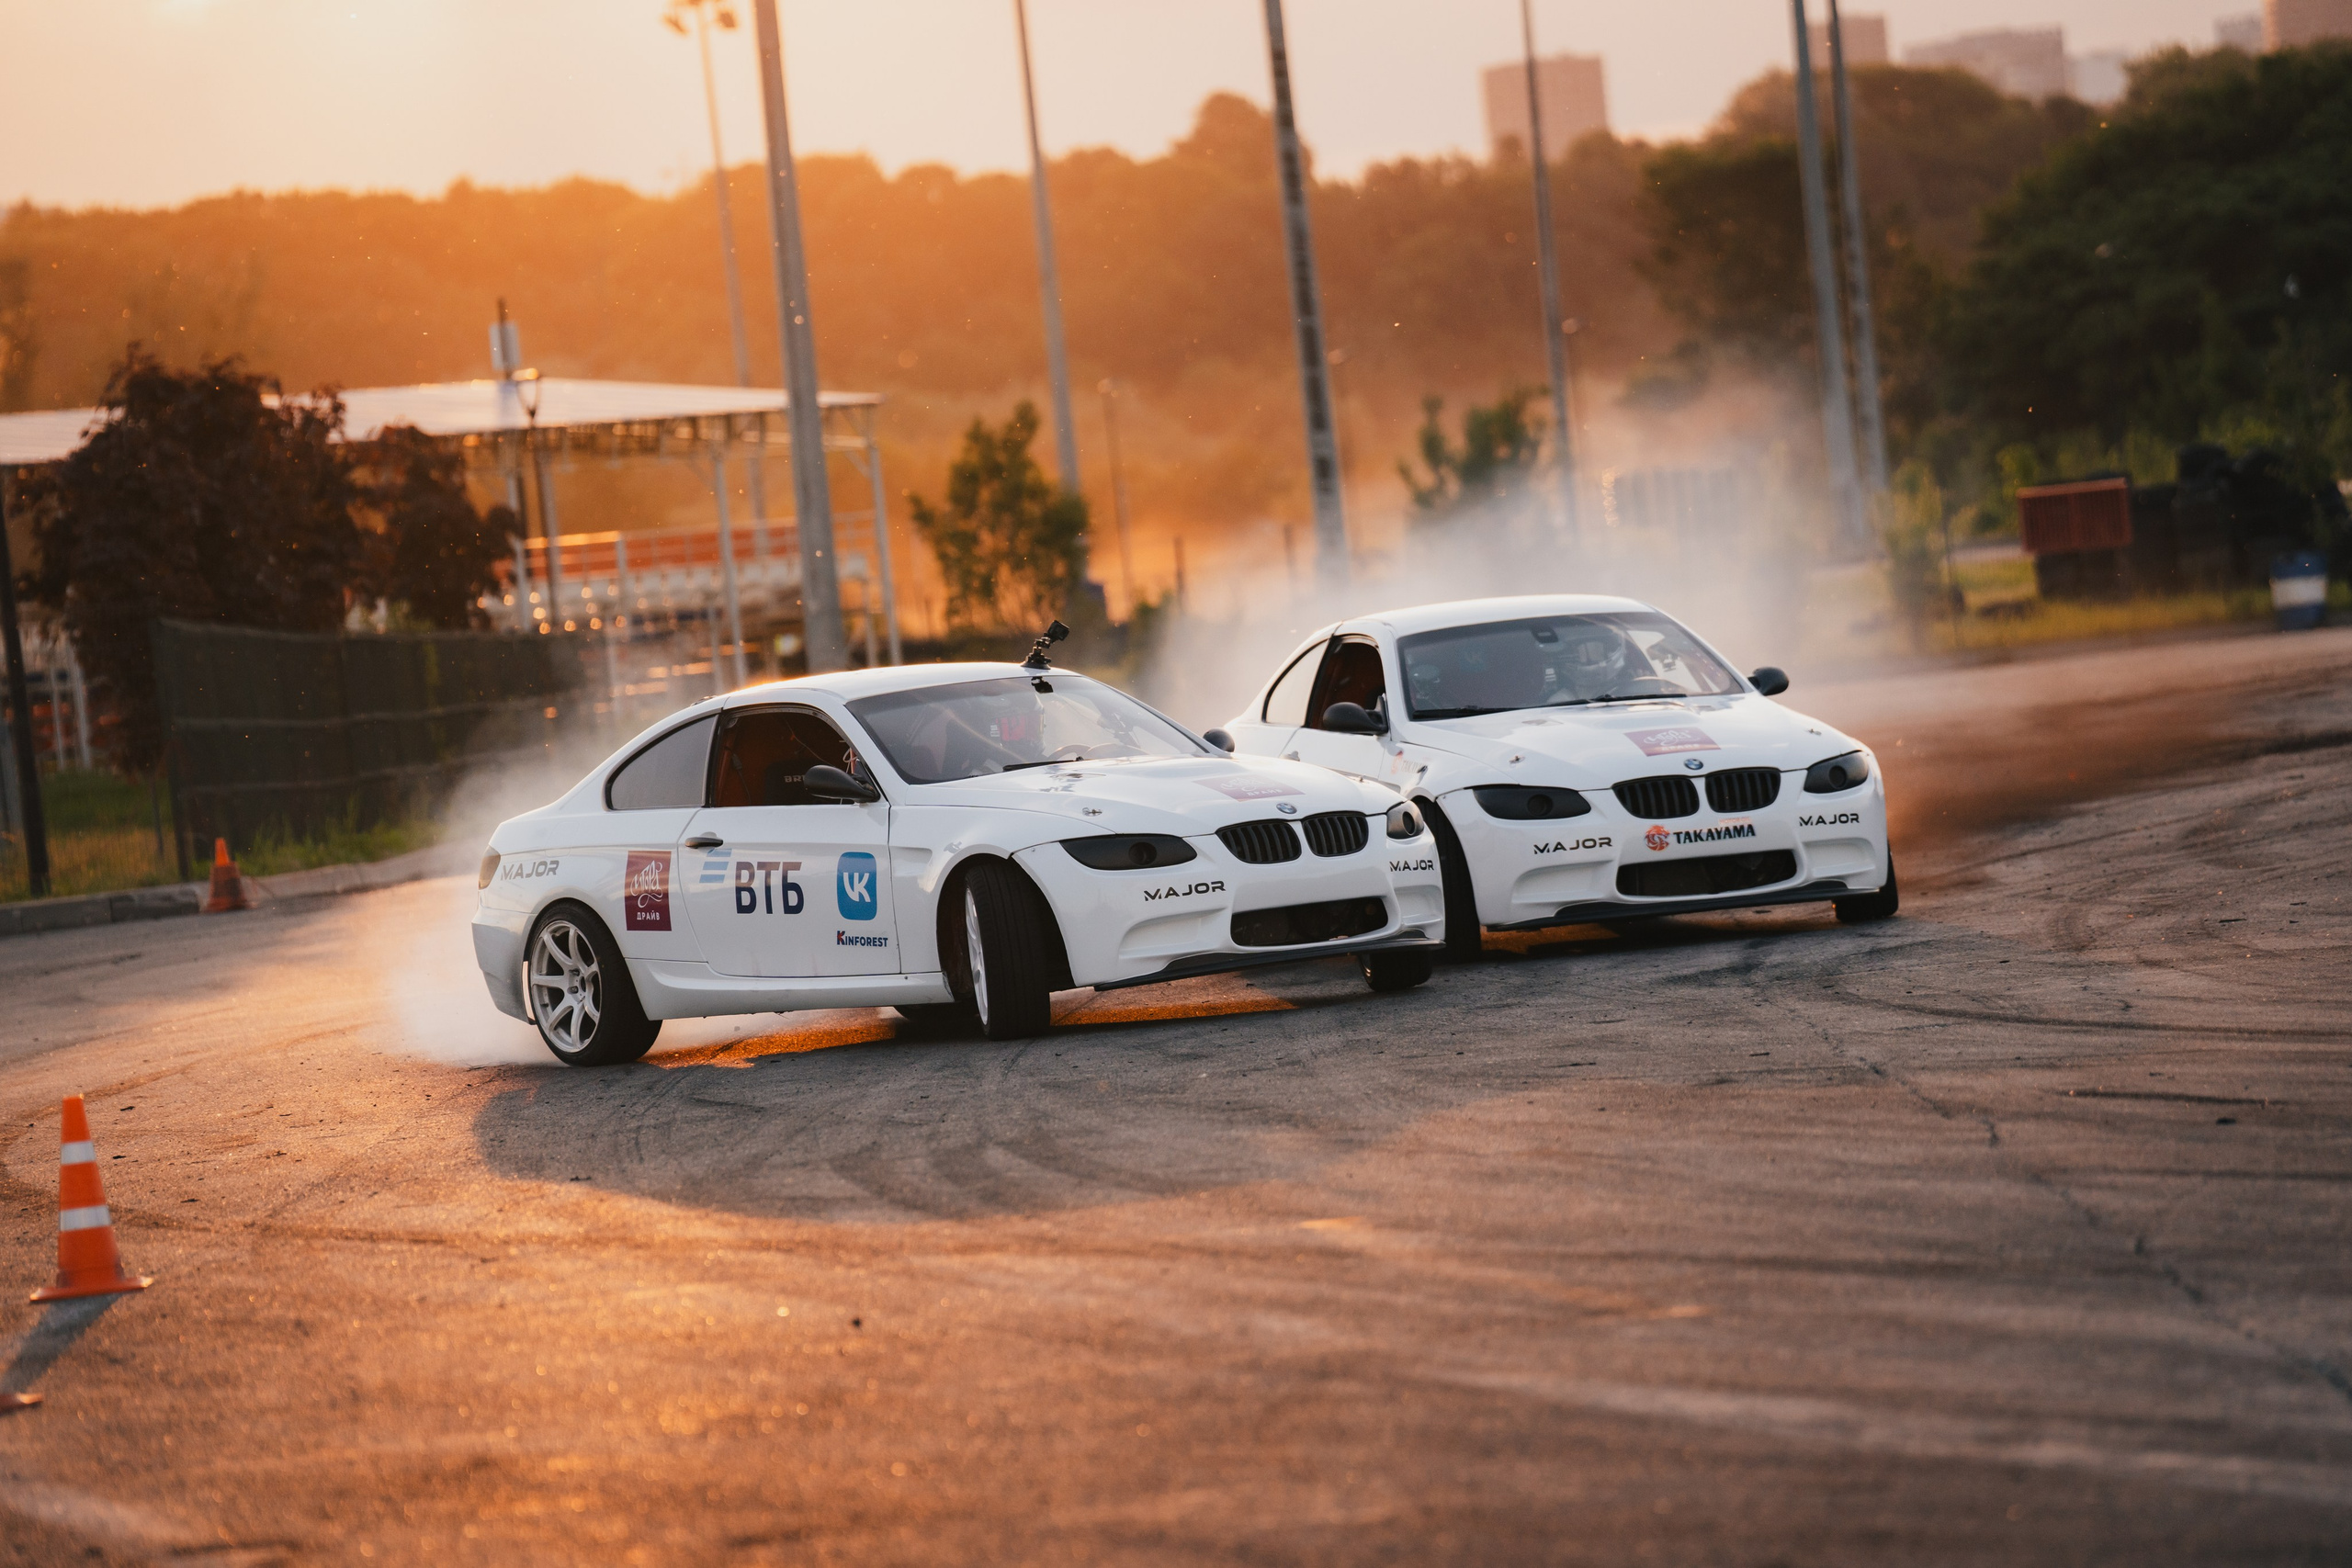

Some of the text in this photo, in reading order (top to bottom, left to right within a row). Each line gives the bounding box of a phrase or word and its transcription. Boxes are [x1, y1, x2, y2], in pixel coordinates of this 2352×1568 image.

[1798, 813, 1860, 827] MAJOR
[1673, 824, 1756, 844] TAKAYAMA
[1533, 837, 1612, 855] MAJOR
[500, 860, 560, 882] MAJOR
[1389, 860, 1435, 873] MAJOR
[735, 861, 805, 915] ВТБ
[842, 872, 871, 903] VK
[1144, 880, 1227, 902] MAJOR
[636, 909, 661, 920] ДРАЙВ
